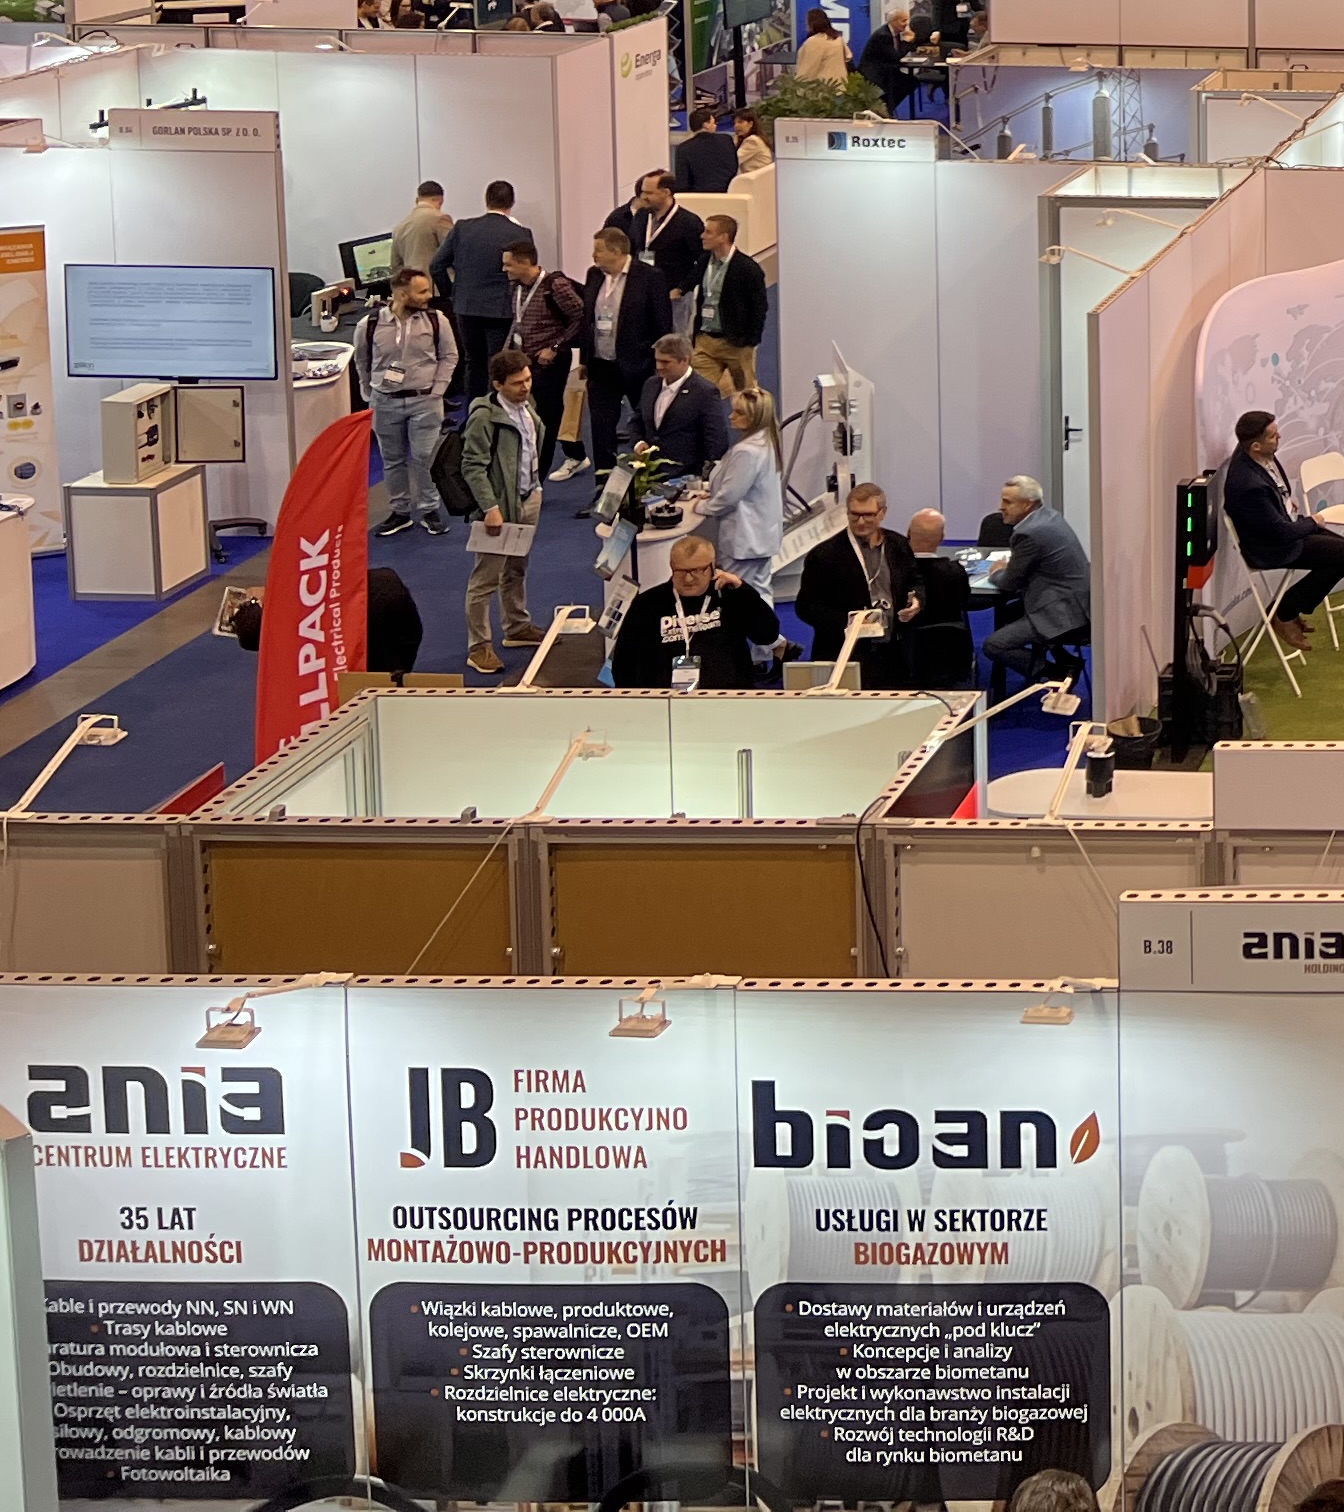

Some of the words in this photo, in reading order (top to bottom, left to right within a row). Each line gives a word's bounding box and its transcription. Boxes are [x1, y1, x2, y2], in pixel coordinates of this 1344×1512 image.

[635, 48, 662, 69] Energa
[152, 127, 185, 136] GORLAN
[188, 127, 219, 136] POLSKA
[851, 135, 906, 149] Roxtec
[660, 610, 720, 628] Dierse
[1144, 939, 1173, 955] B.38
[1304, 963, 1344, 974] HOLDING
[400, 1067, 497, 1168] JB
[514, 1069, 587, 1093] FIRMA
[515, 1107, 687, 1131] PRODUKCYJNO
[33, 1145, 132, 1168] CENTRUM
[141, 1146, 288, 1169] ELEKTRYCZNE
[516, 1146, 648, 1169] HANDLOWA
[120, 1206, 149, 1230] 35
[157, 1207, 196, 1230] LAT
[393, 1206, 558, 1231] OUTSOURCING
[567, 1200, 698, 1231] PROCESÓW
[815, 1208, 898, 1232] USŁUGI
[907, 1209, 926, 1232] W
[934, 1208, 1048, 1232] SEKTORZE
[78, 1233, 243, 1264] DZIAŁALNOŚCI
[367, 1234, 726, 1264] MONTAŻOWO-PRODUKCYJNYCH
[854, 1242, 1009, 1265] BIOGAZOWYM
[98, 1299, 182, 1319] przewody
[224, 1300, 247, 1315] SN
[261, 1300, 294, 1315] WN
[422, 1301, 476, 1319] Wiązki
[481, 1302, 557, 1319] kablowe,
[562, 1302, 674, 1321] produktowe,
[799, 1301, 872, 1320] Dostawy
[876, 1301, 973, 1317] materiałów
[987, 1299, 1066, 1320] urządzeń
[103, 1320, 151, 1339] Trasy
[154, 1321, 228, 1336] kablowe
[428, 1321, 508, 1340] kolejowe,
[513, 1323, 621, 1341] spawalnicze,
[626, 1323, 668, 1337] OEM
[824, 1322, 940, 1340] elektrycznych
[109, 1343, 201, 1357] modułowa
[214, 1342, 318, 1357] sterownicza
[472, 1344, 517, 1363] Szafy
[521, 1345, 624, 1359] sterownicze
[853, 1344, 939, 1363] Koncepcje
[953, 1343, 1013, 1361] analizy
[138, 1363, 244, 1379] rozdzielnice,
[248, 1362, 293, 1380] szafy
[464, 1365, 535, 1383] Skrzynki
[539, 1365, 635, 1384] łączeniowe
[836, 1367, 851, 1379] w
[855, 1364, 930, 1380] obszarze
[935, 1364, 1029, 1379] biometanu
[131, 1386, 196, 1402] oprawy
[209, 1382, 263, 1398] źródła
[267, 1383, 328, 1398] światła
[444, 1385, 548, 1401] Rozdzielnice
[553, 1387, 656, 1404] elektryczne:
[797, 1385, 857, 1403] Projekt
[870, 1385, 991, 1403] wykonawstwo
[997, 1384, 1070, 1403] instalacji
[54, 1404, 122, 1423] Osprzęt
[125, 1405, 291, 1423] elektroinstalacyjny,
[456, 1407, 556, 1426] konstrukcje
[560, 1407, 583, 1422] do
[780, 1405, 895, 1424] elektrycznych
[899, 1405, 925, 1421] dla
[930, 1405, 988, 1424] branży
[992, 1404, 1088, 1424] biogazowej
[112, 1425, 220, 1444] odgromowy,
[224, 1425, 296, 1444] kablowy
[834, 1426, 894, 1446] Rozwój
[898, 1426, 992, 1446] technologii
[996, 1427, 1034, 1442] R&D
[155, 1446, 195, 1460] kabli
[209, 1446, 310, 1464] przewodów
[846, 1448, 871, 1463] dla
[876, 1448, 924, 1466] rynku
[930, 1447, 1022, 1463] biometanu
[121, 1466, 231, 1481] Fotowoltaika
